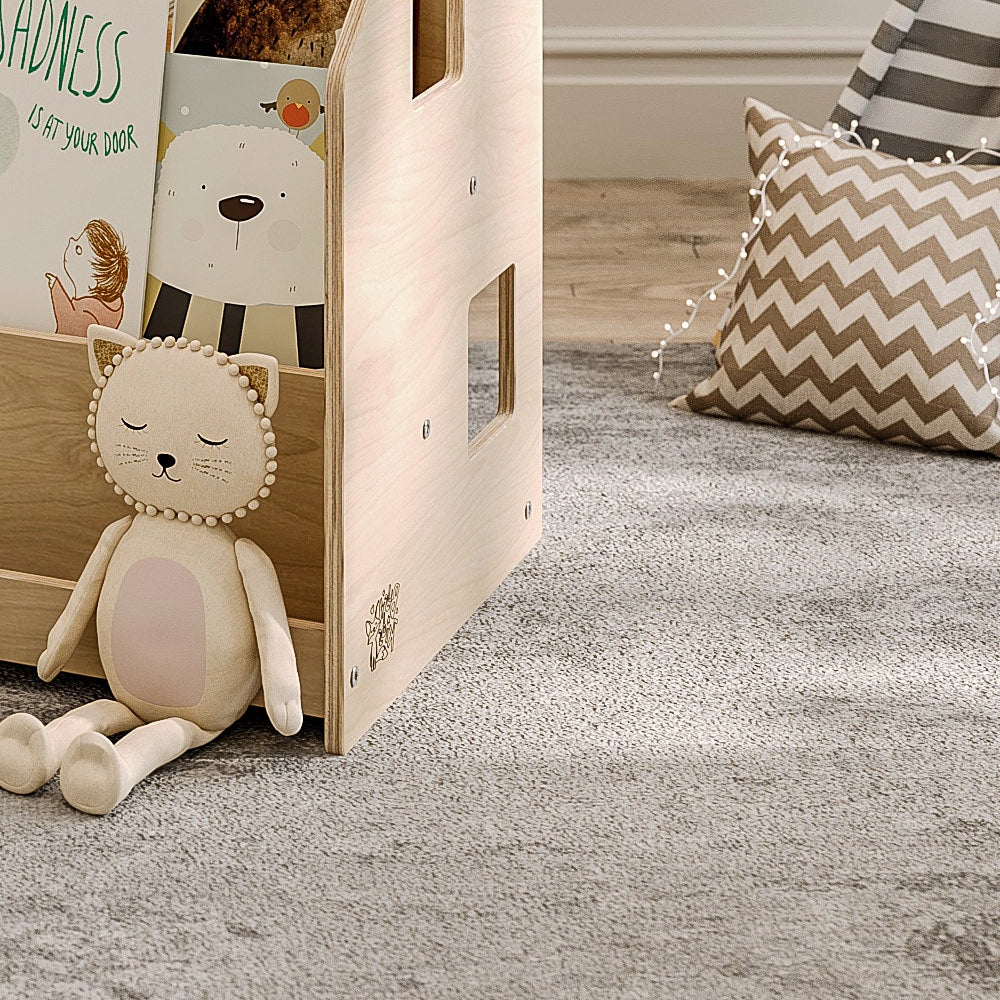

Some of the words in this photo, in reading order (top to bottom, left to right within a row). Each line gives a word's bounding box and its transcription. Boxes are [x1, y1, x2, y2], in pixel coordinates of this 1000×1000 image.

[27, 103, 44, 130] IS
[42, 114, 64, 140] AT
[61, 122, 99, 156] YOUR
[104, 124, 139, 157] DOOR
